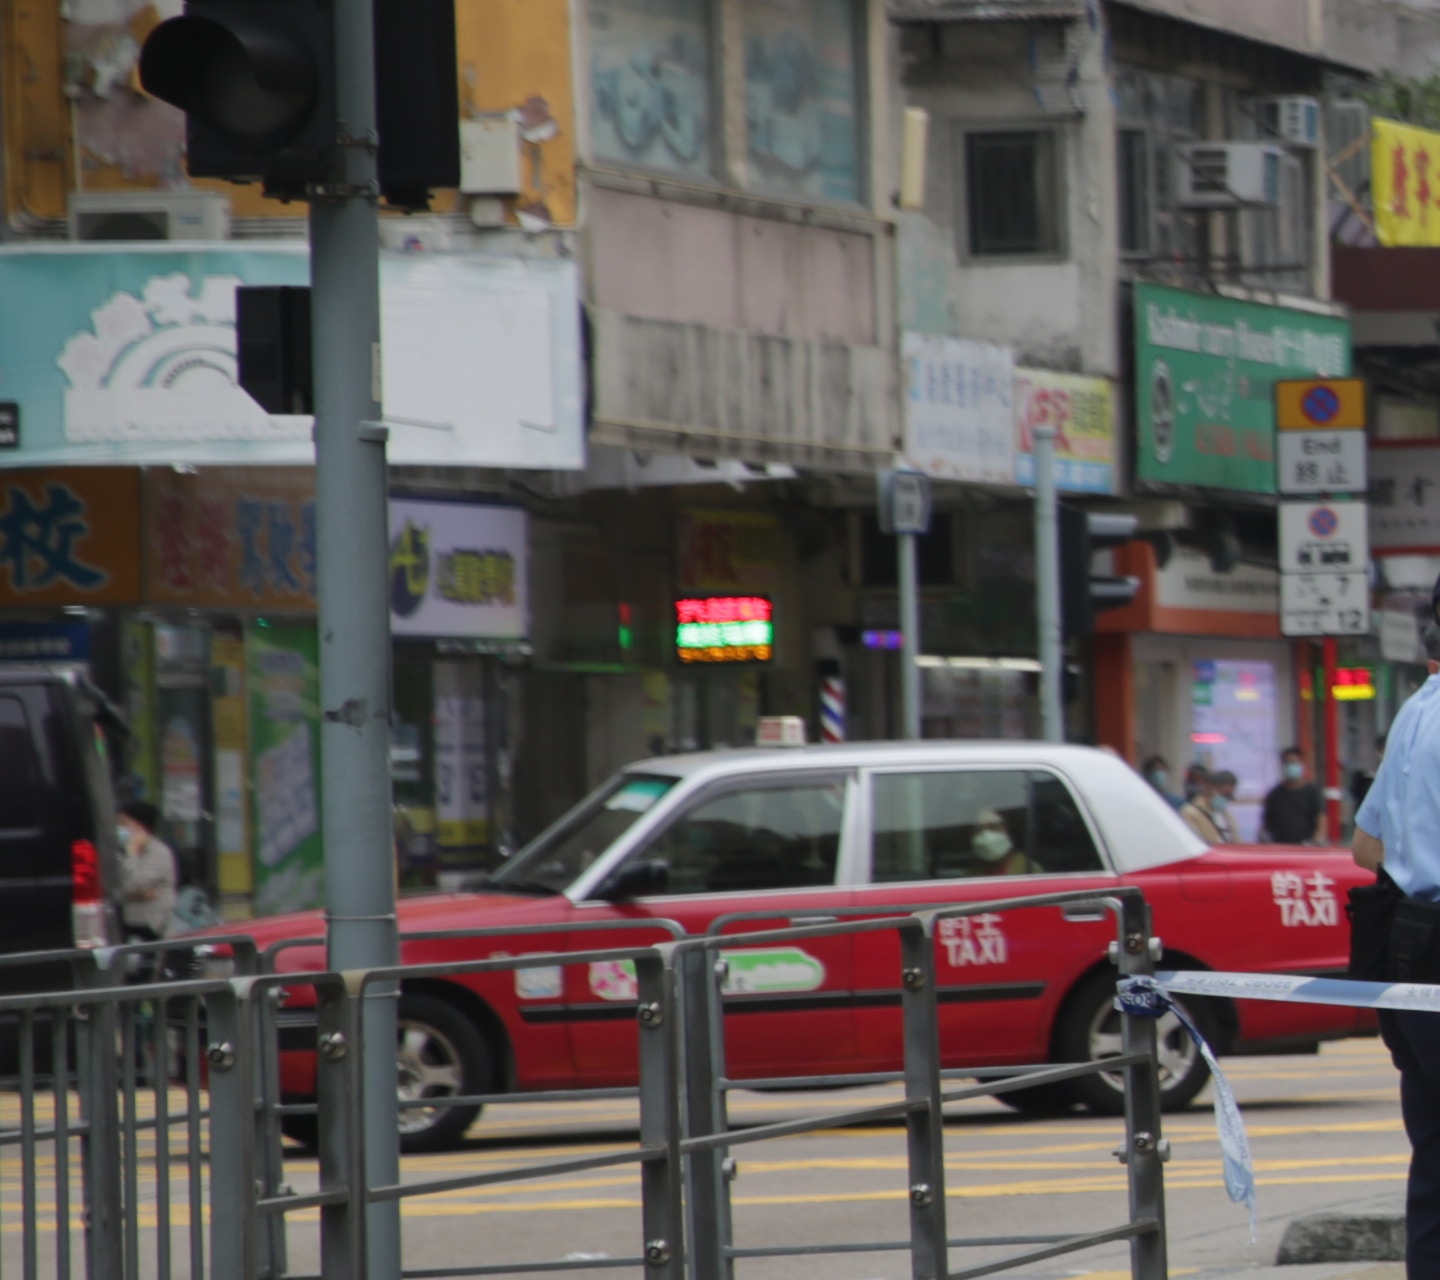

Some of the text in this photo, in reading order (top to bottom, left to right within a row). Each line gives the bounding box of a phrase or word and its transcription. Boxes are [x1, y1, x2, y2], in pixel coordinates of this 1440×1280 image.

[1302, 437, 1342, 455] End
[1294, 460, 1350, 486] 終止
[1270, 869, 1336, 899] 的士
[1274, 898, 1337, 926] TAXI
[938, 915, 1005, 938] 的士
[943, 937, 1006, 966] TAXI
